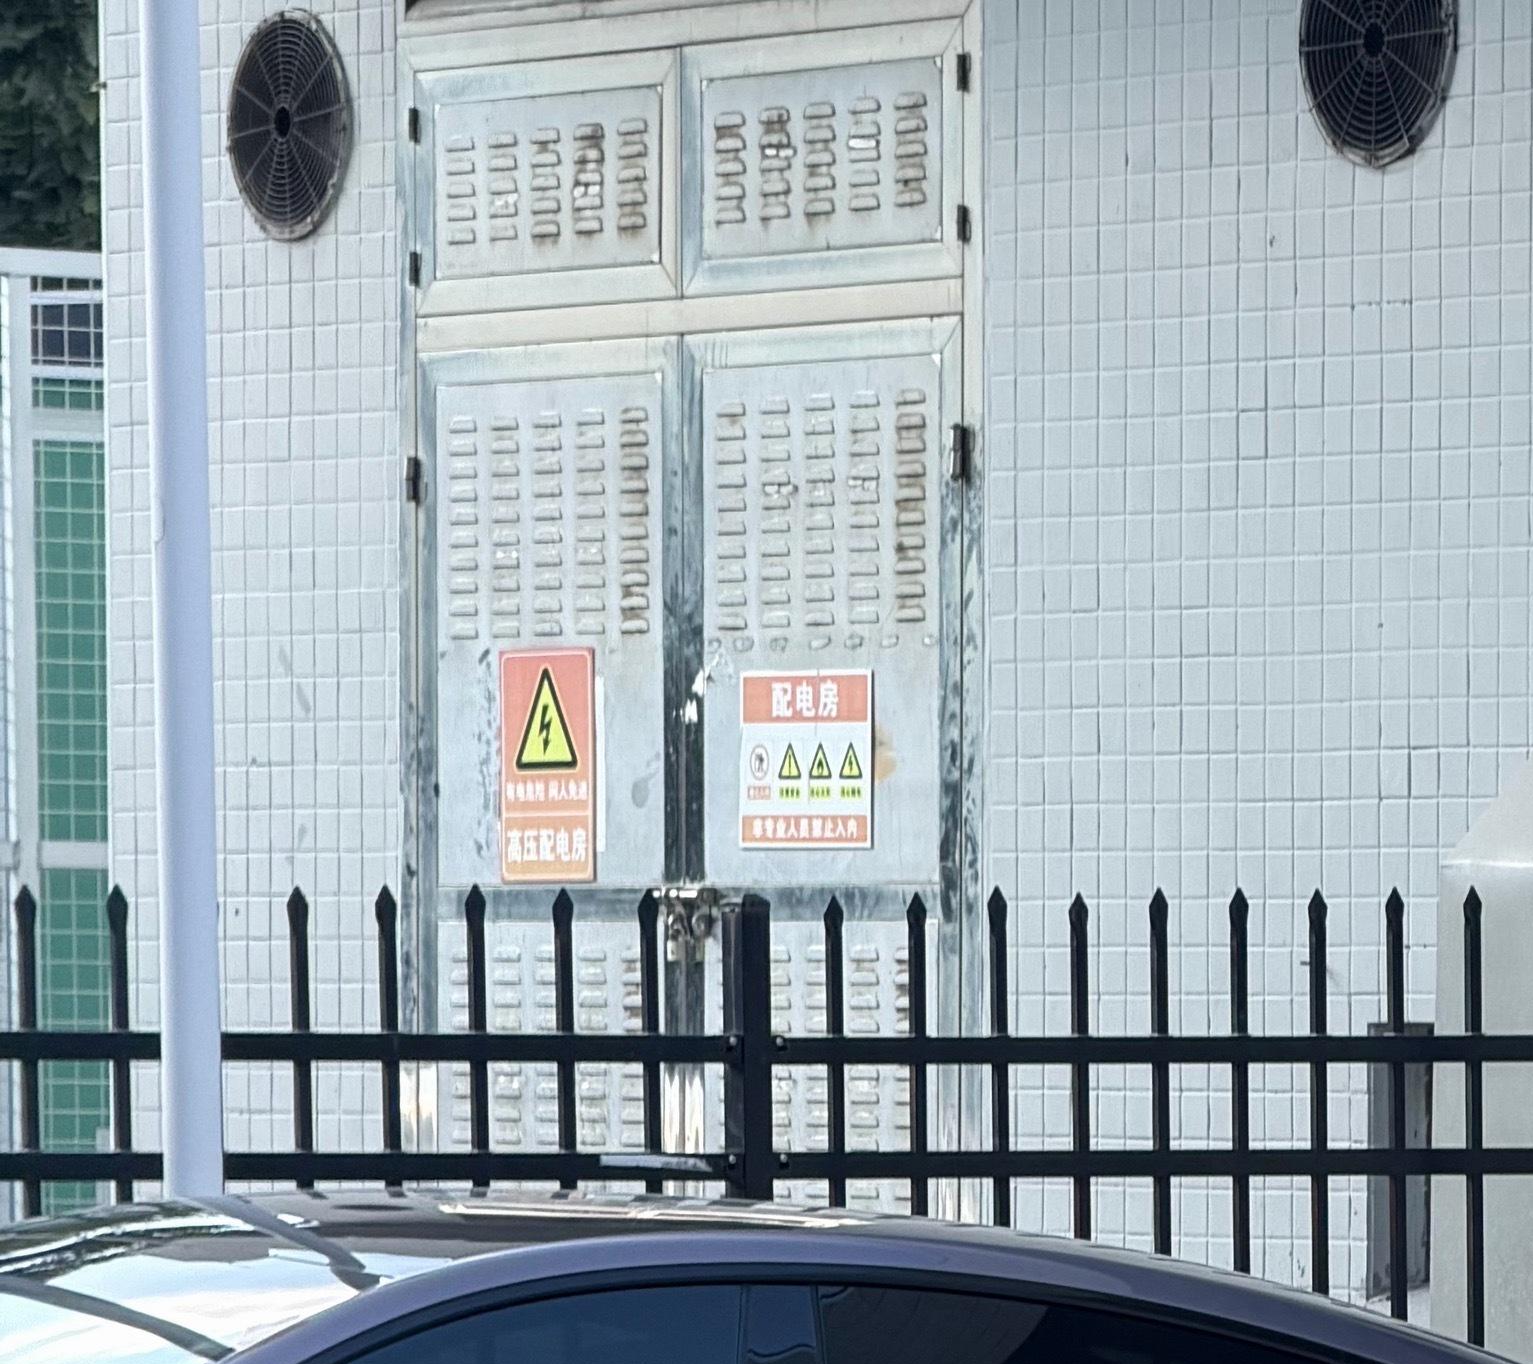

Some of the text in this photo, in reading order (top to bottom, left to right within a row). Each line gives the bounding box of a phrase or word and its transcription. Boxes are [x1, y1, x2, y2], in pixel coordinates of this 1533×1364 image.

[771, 680, 839, 718] 配电房
[506, 826, 587, 863] 高压配电房
